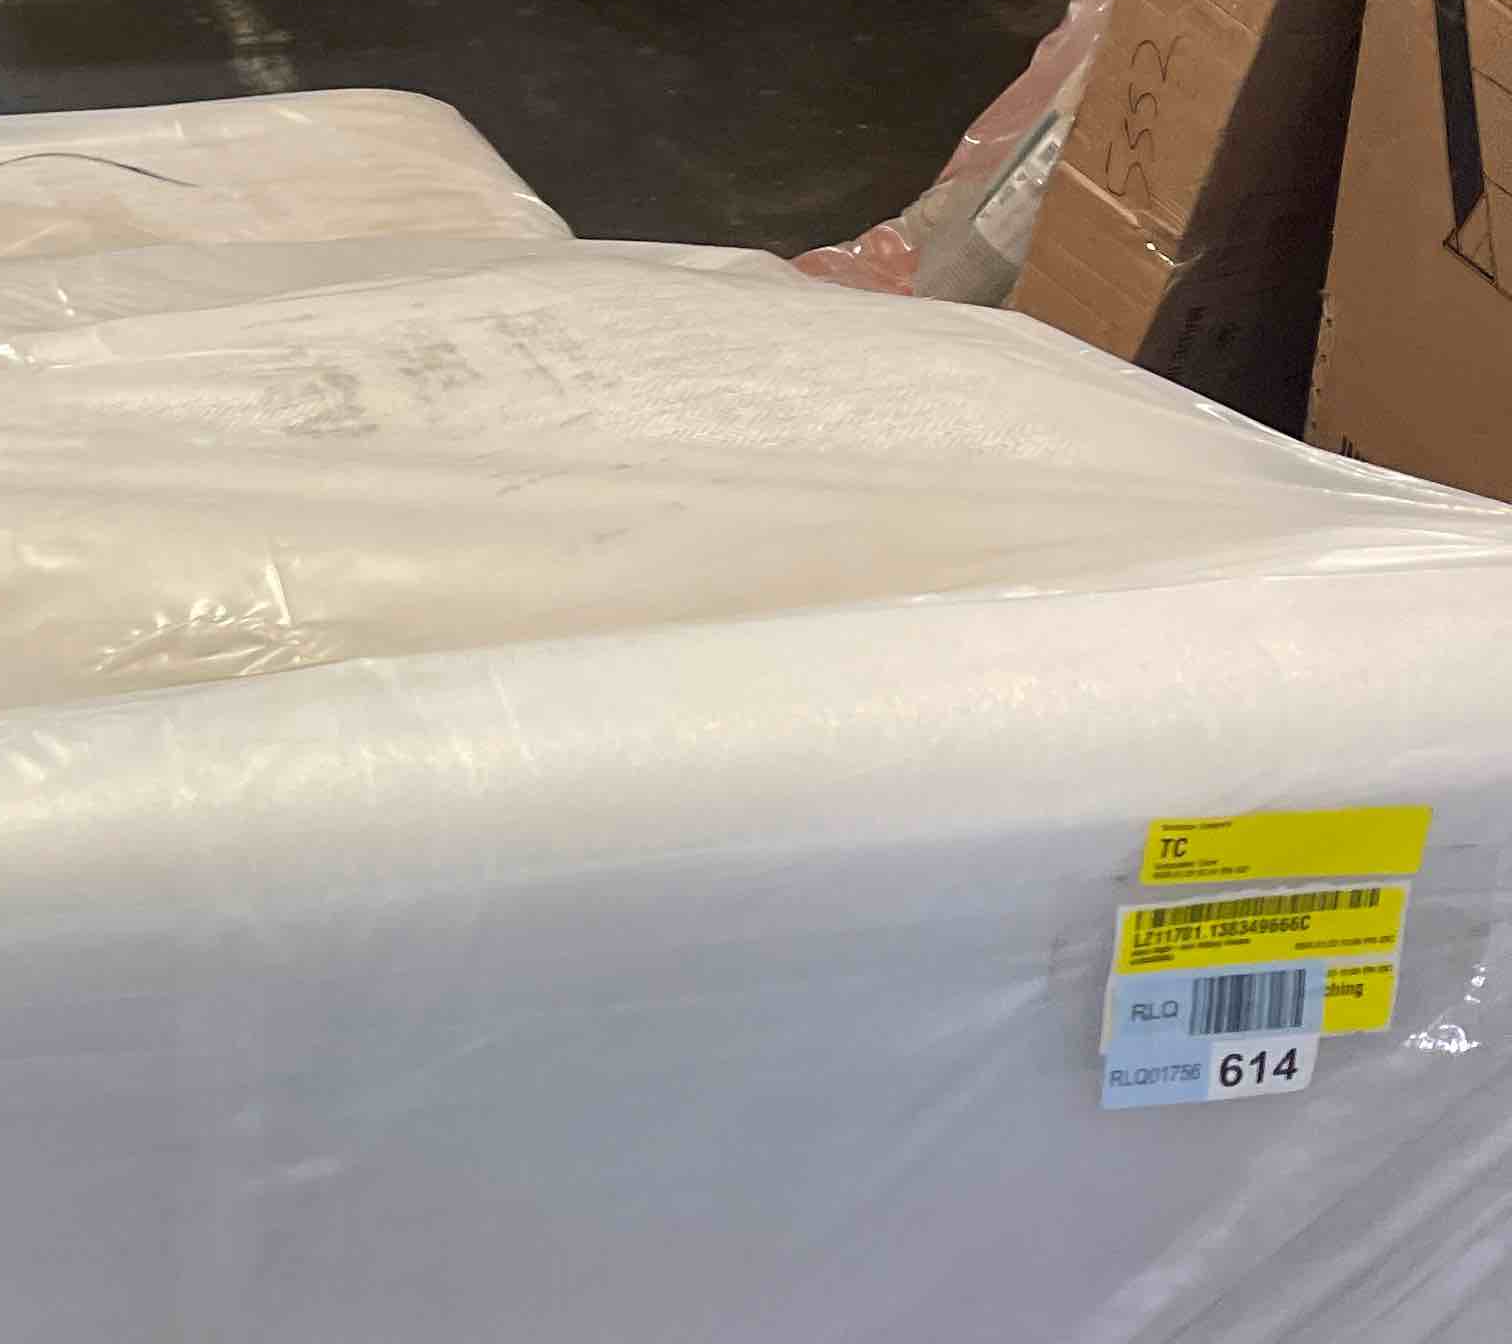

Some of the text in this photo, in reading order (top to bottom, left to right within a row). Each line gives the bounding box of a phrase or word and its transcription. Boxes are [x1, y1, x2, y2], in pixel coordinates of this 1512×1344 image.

[1159, 837, 1189, 859] TC
[1130, 1000, 1179, 1023] RLQ
[1218, 1047, 1299, 1088] 614
